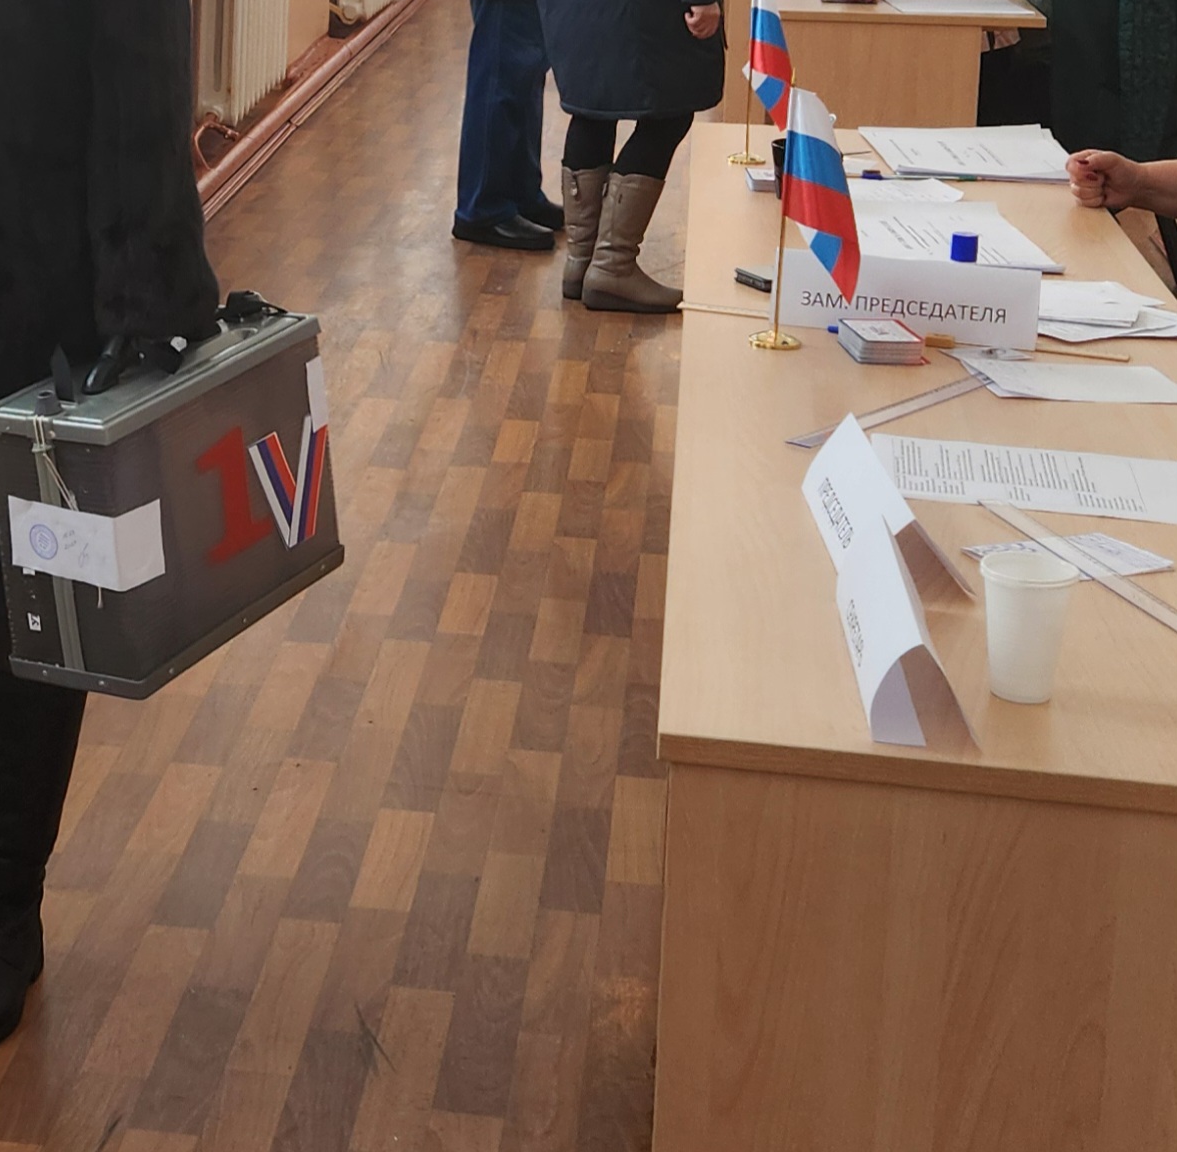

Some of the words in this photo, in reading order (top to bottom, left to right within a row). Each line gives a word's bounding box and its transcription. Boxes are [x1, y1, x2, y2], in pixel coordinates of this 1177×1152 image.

[801, 291, 849, 310] ЗАМ.
[856, 295, 1007, 324] ПРЕДСЕДАТЕЛЯ
[195, 425, 273, 569] 1
